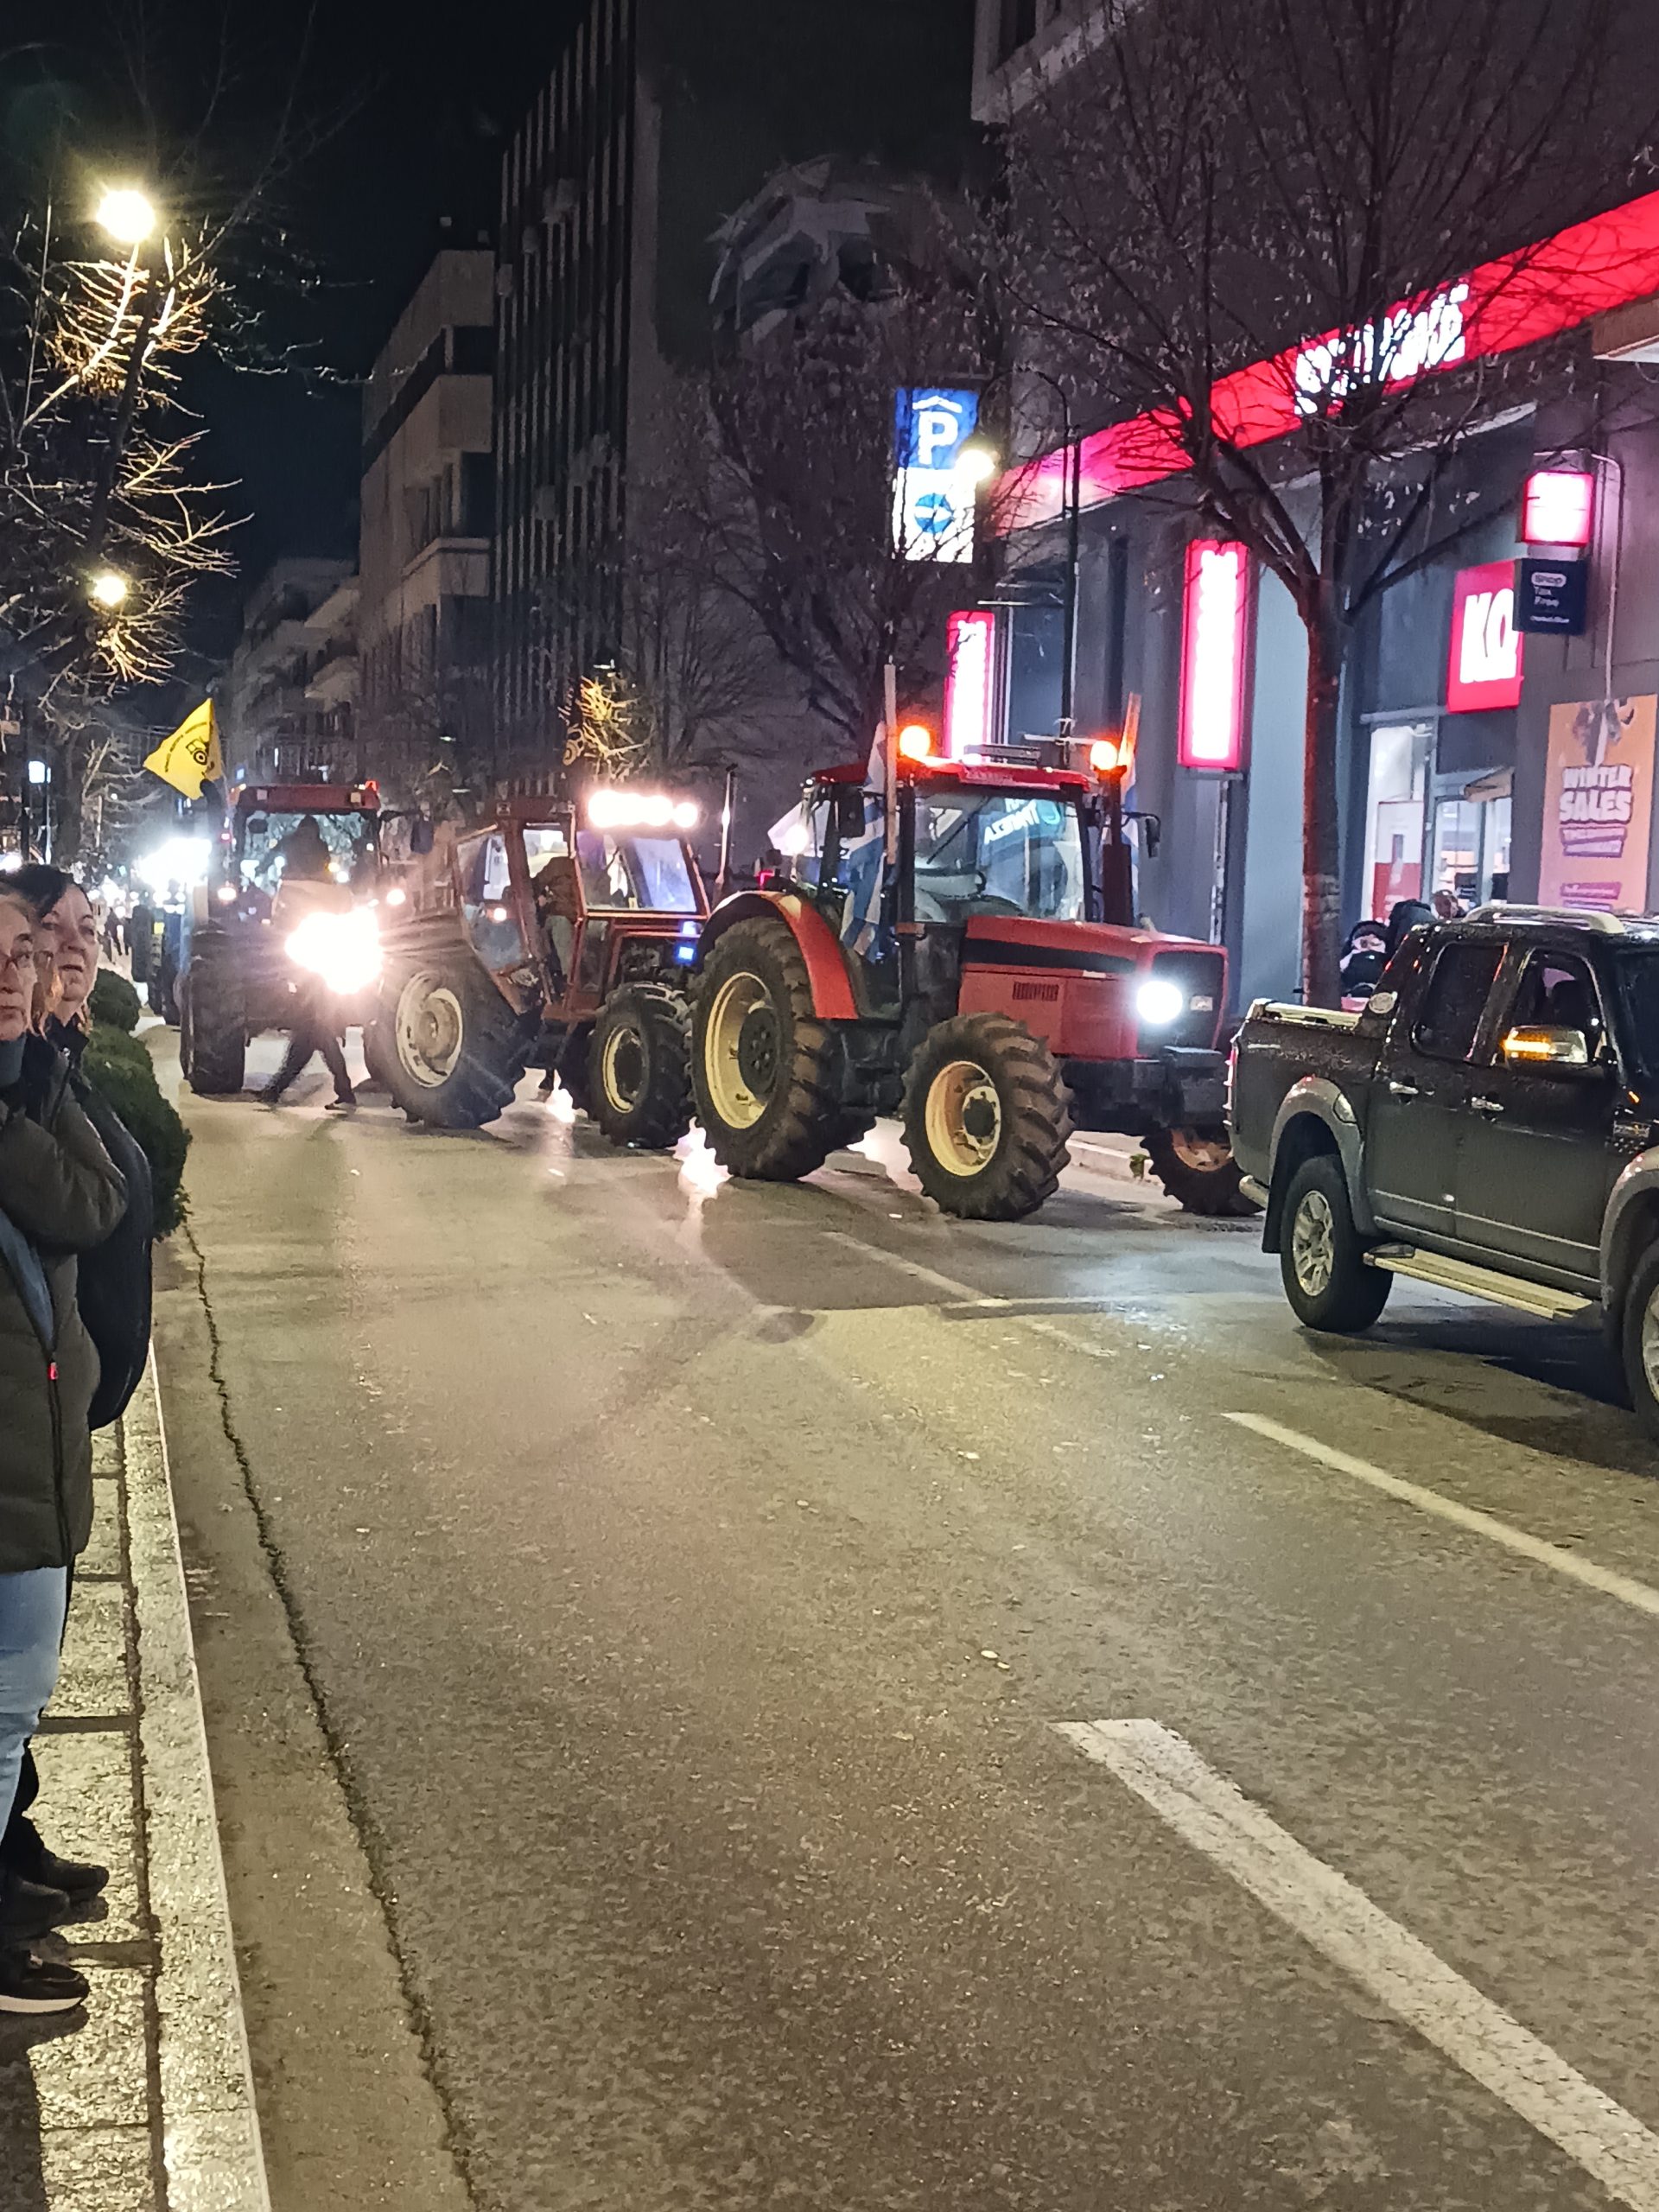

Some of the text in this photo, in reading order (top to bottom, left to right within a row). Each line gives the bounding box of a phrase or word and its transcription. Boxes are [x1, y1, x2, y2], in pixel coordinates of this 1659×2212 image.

[918, 410, 958, 465] P
[1562, 765, 1632, 789] WINTER
[1559, 789, 1632, 823] SALES
